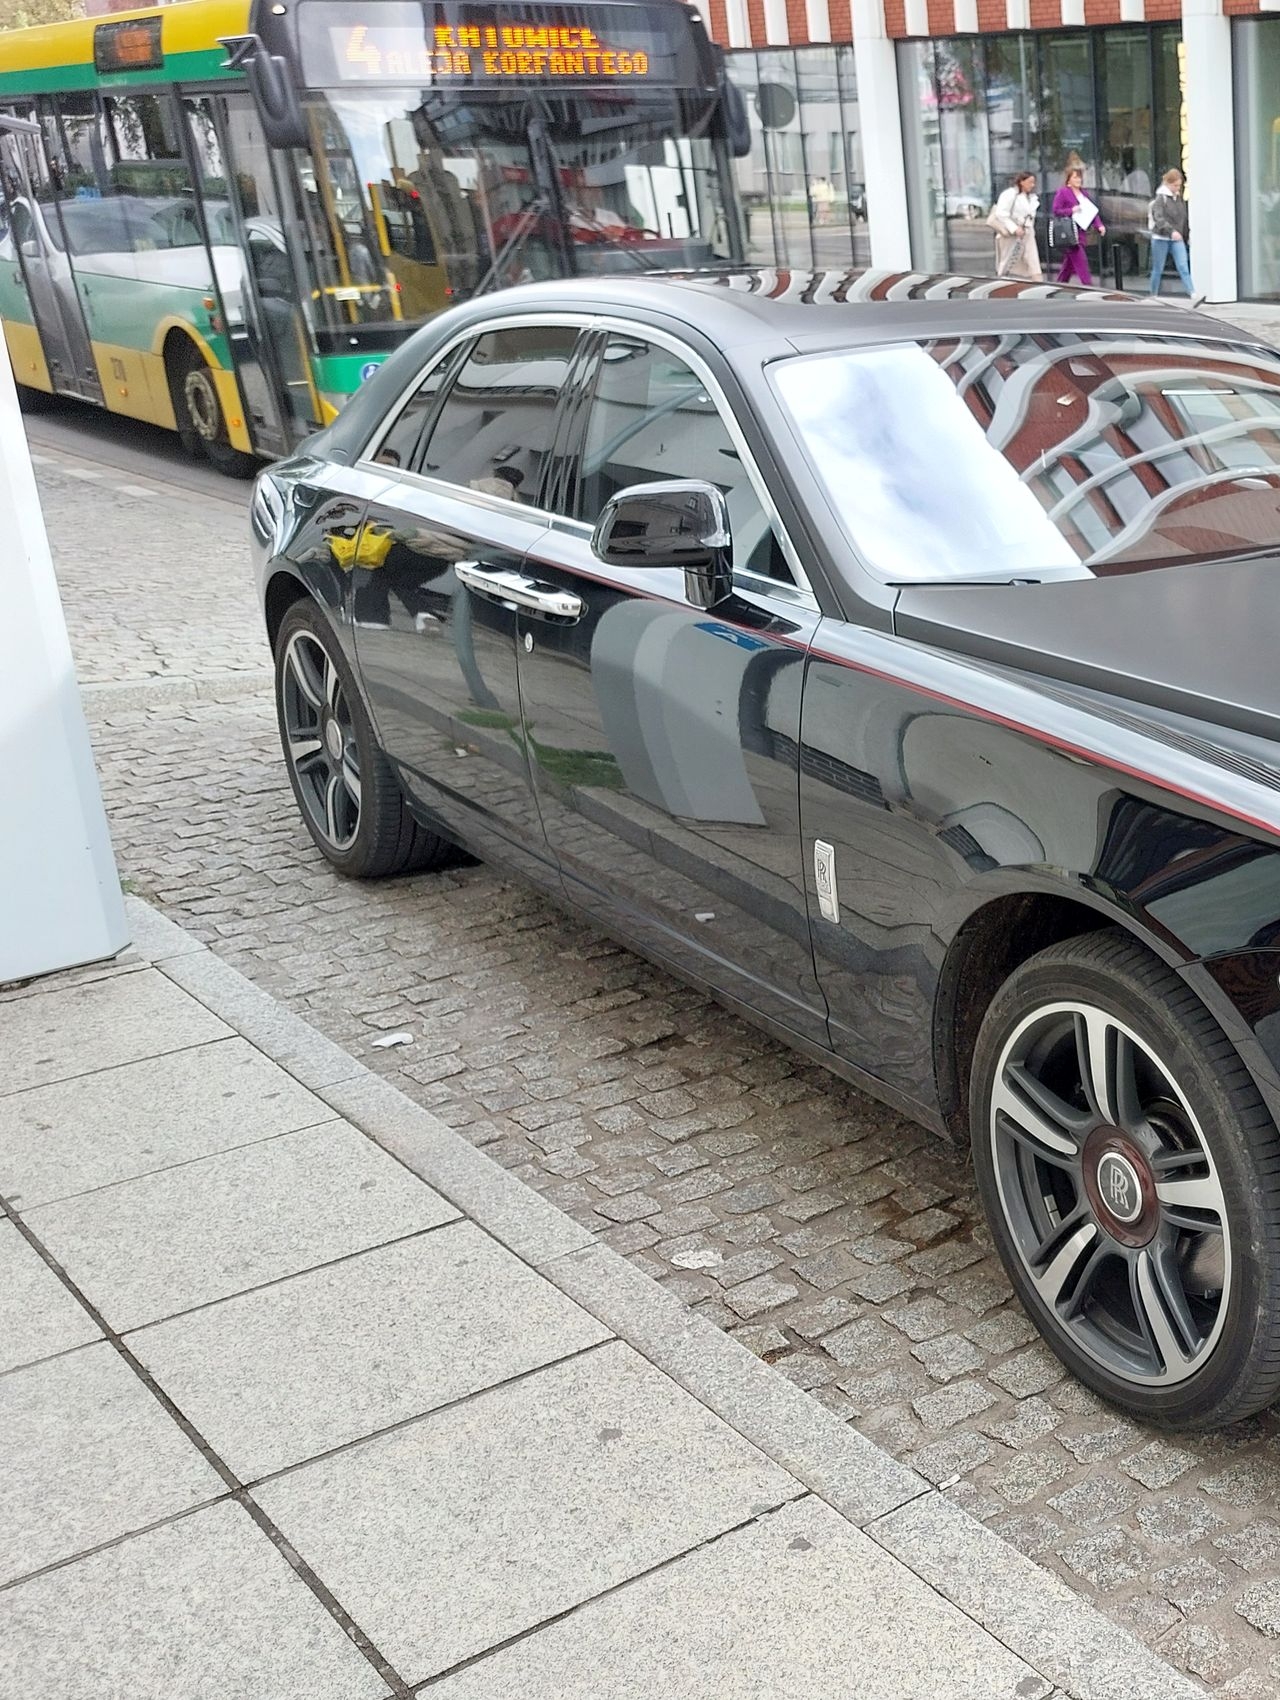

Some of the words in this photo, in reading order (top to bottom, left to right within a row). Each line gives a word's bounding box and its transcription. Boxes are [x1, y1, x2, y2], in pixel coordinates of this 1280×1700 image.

[434, 25, 600, 49] KATOWICE
[346, 25, 381, 75] 4
[388, 50, 472, 75] ALEJA
[482, 50, 648, 75] KORFANTEGO
